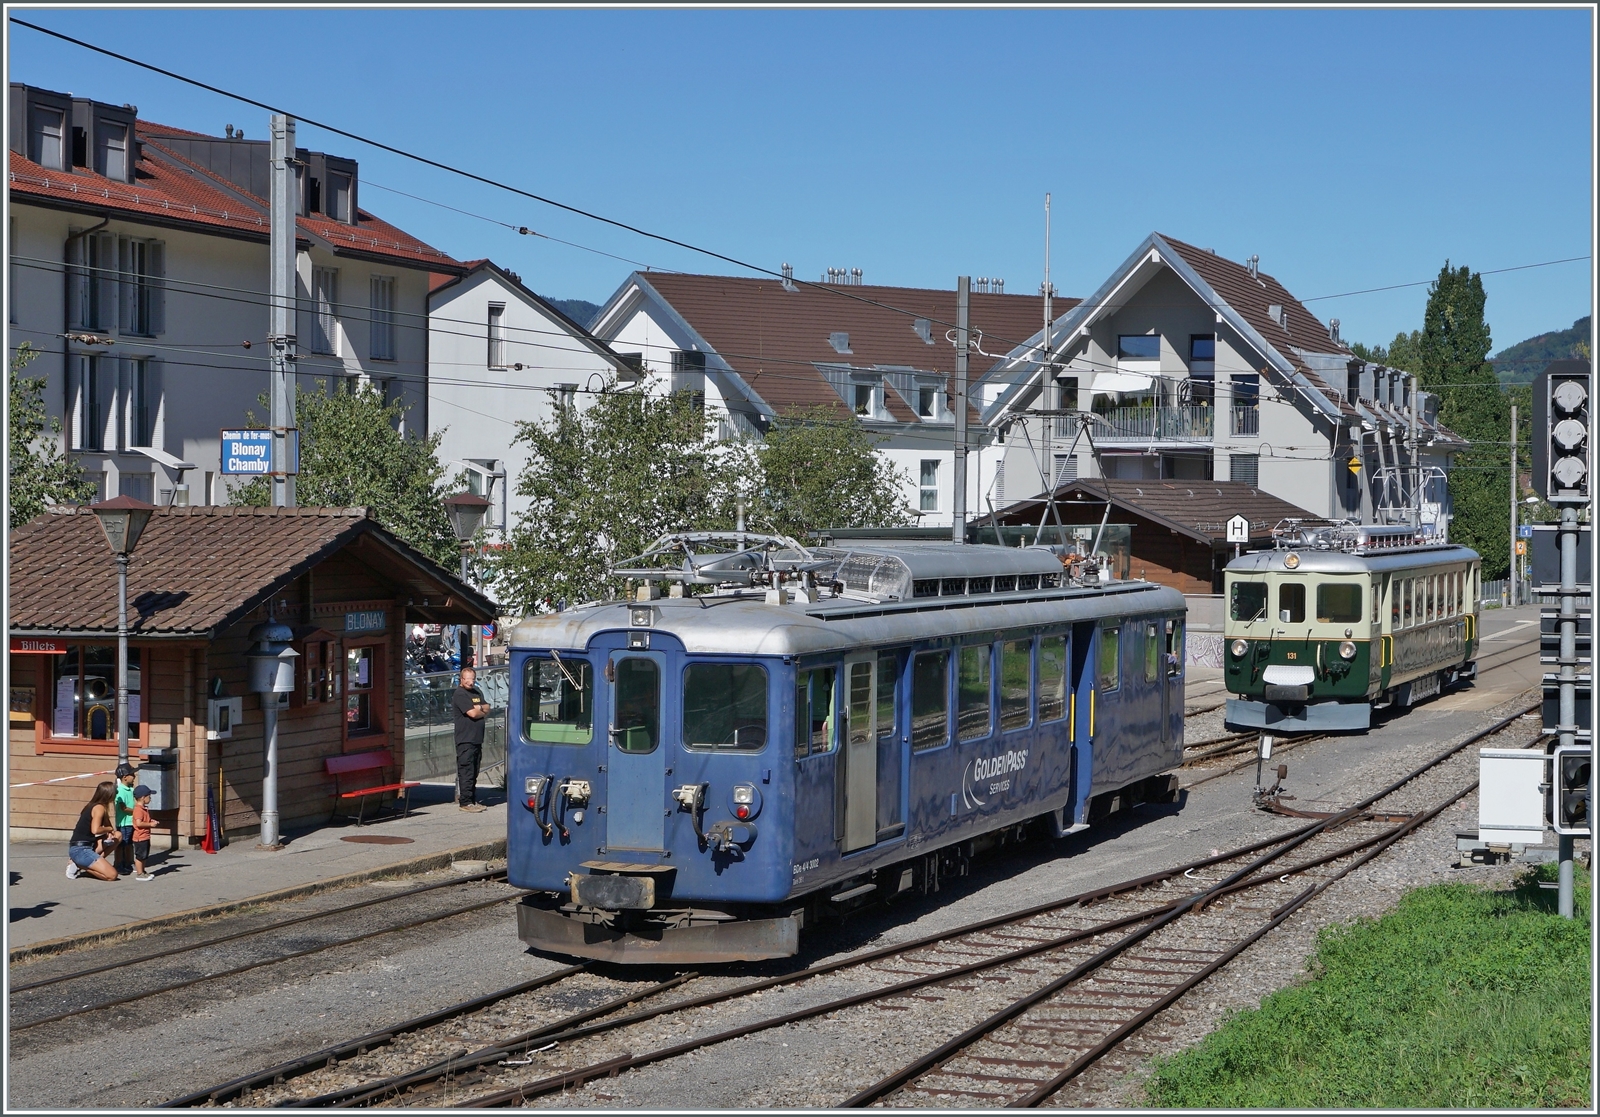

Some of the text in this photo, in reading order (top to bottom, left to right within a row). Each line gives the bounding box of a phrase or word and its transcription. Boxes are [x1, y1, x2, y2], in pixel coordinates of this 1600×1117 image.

[222, 430, 241, 440] Chemin
[243, 430, 249, 440] de
[231, 442, 266, 457] Blonay
[228, 458, 269, 473] Chamby
[1232, 521, 1243, 536] H
[347, 612, 384, 630] BLONAY
[21, 641, 56, 651] Billets
[1287, 652, 1297, 660] 131
[989, 780, 1010, 795] SERVICES
